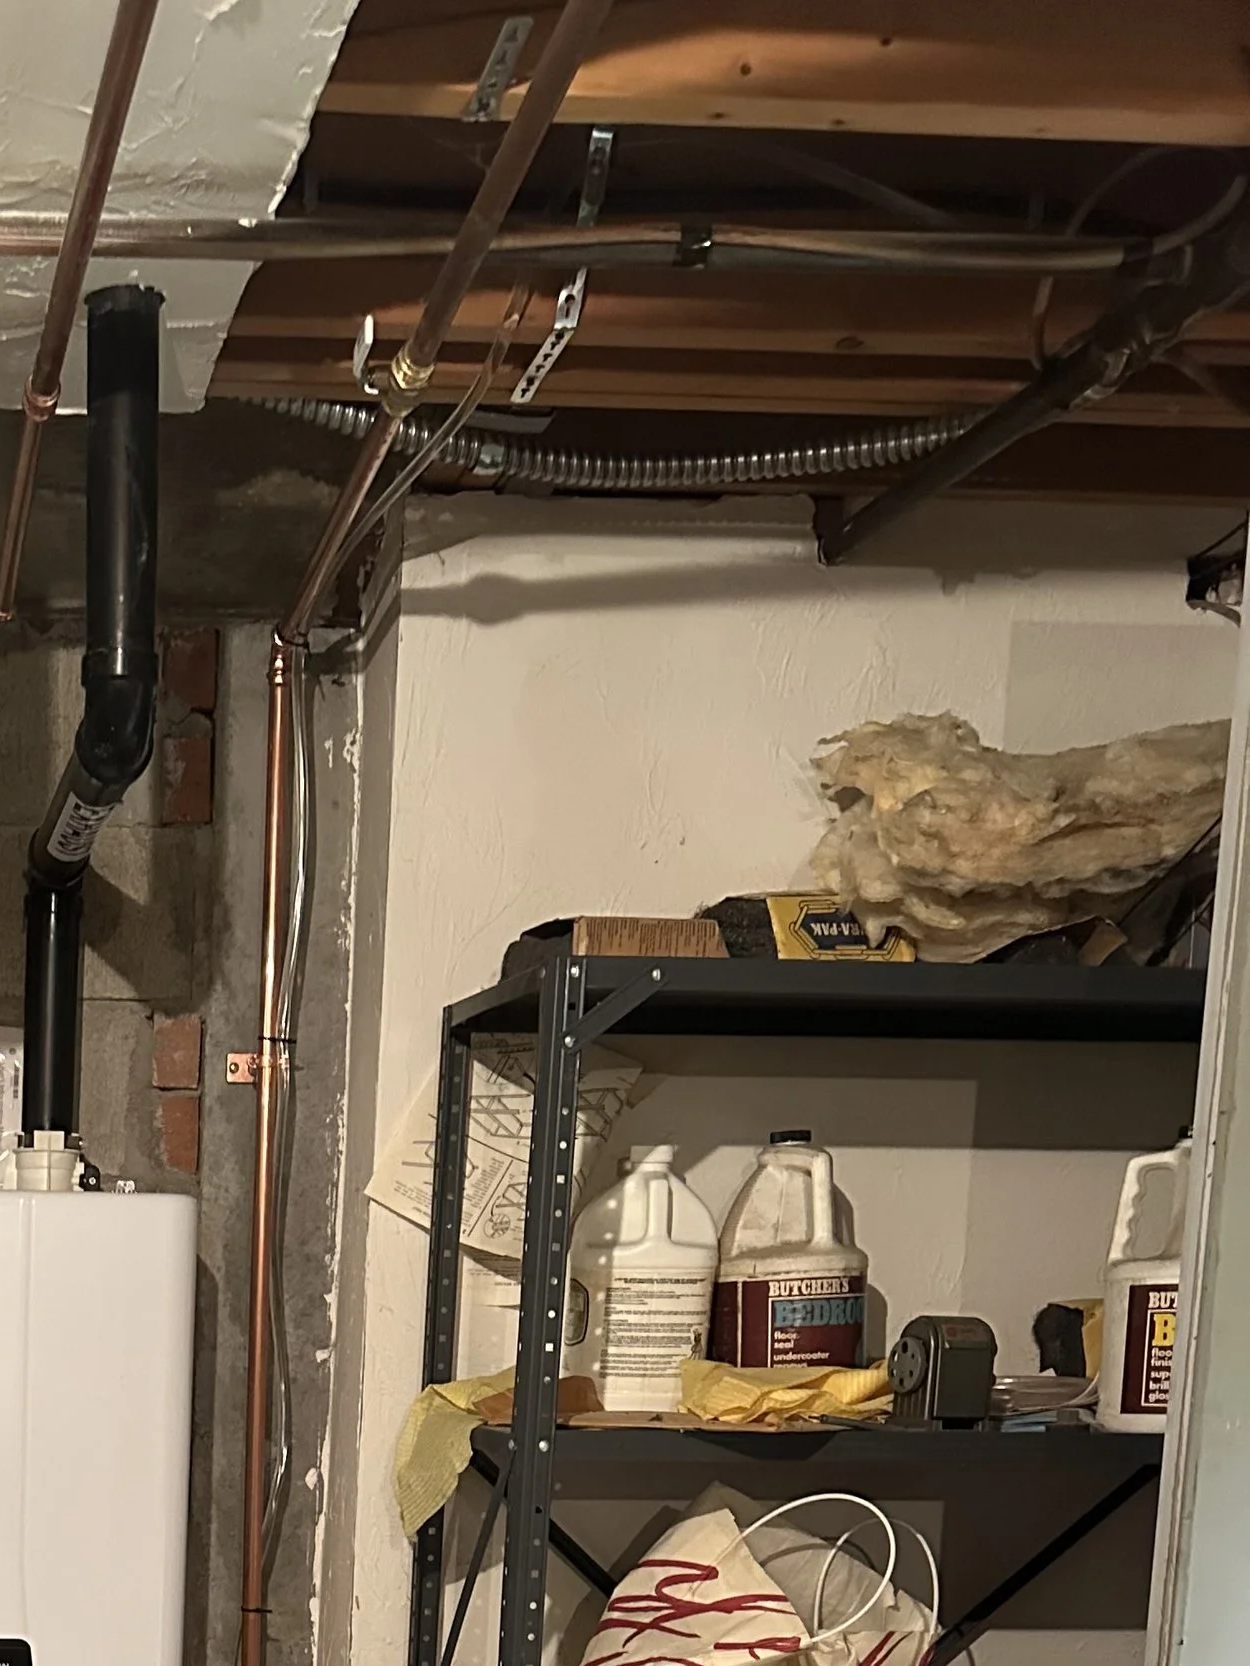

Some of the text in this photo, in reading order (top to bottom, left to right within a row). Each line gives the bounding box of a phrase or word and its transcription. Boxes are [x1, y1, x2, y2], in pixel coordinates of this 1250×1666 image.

[774, 1331, 798, 1340] floor
[774, 1340, 794, 1349] seal
[773, 1352, 830, 1361] undercoater
